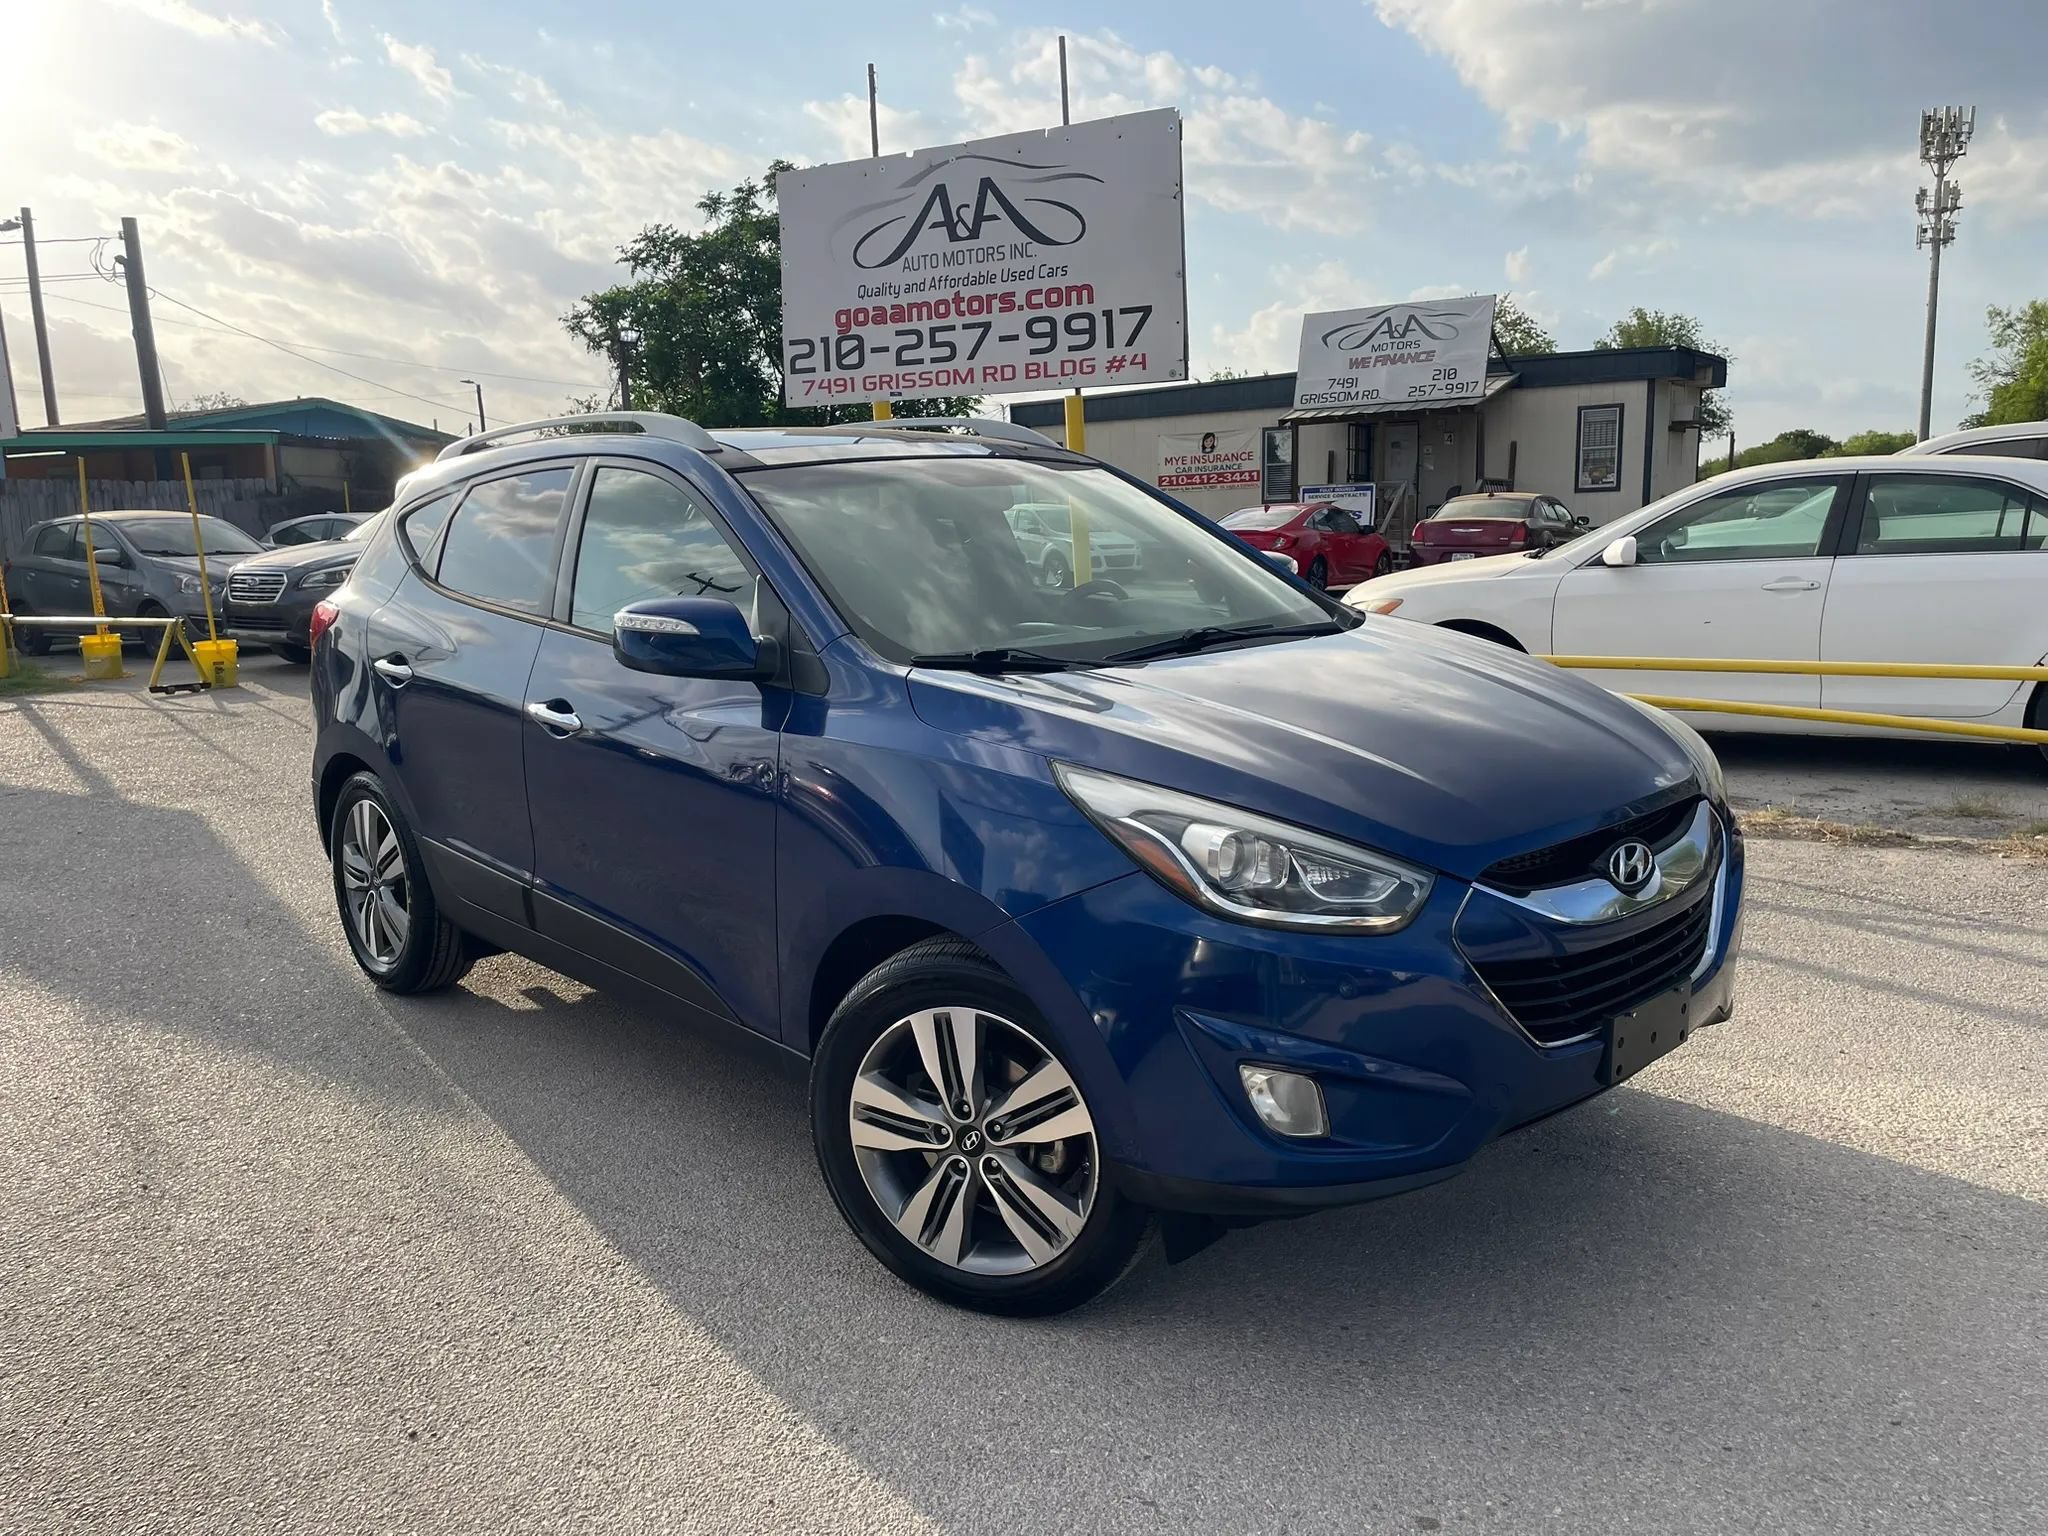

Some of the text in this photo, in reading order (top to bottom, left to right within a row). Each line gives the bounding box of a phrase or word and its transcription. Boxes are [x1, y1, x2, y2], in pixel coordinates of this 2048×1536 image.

[902, 241, 1037, 273] AUTO MOTORS INC.
[857, 263, 1068, 300] Quality and Affordable Used Cars
[835, 283, 1095, 335] goaamotors.com
[789, 304, 1153, 375] 210-257-9917
[1371, 340, 1421, 352] MOTORS
[1349, 350, 1437, 370] WE FINANCE
[802, 353, 1148, 396] 7491 GRISSOM RD BLDG #4
[1432, 368, 1457, 381] 210
[1328, 377, 1358, 390] 7491
[1408, 381, 1479, 398] 257-9917
[1300, 389, 1381, 405] GRISSOM RD.
[1165, 451, 1254, 466] MYE INSURANCE
[1175, 463, 1242, 474] CAR INSURANCE
[1161, 471, 1258, 486] 210-412-3441
